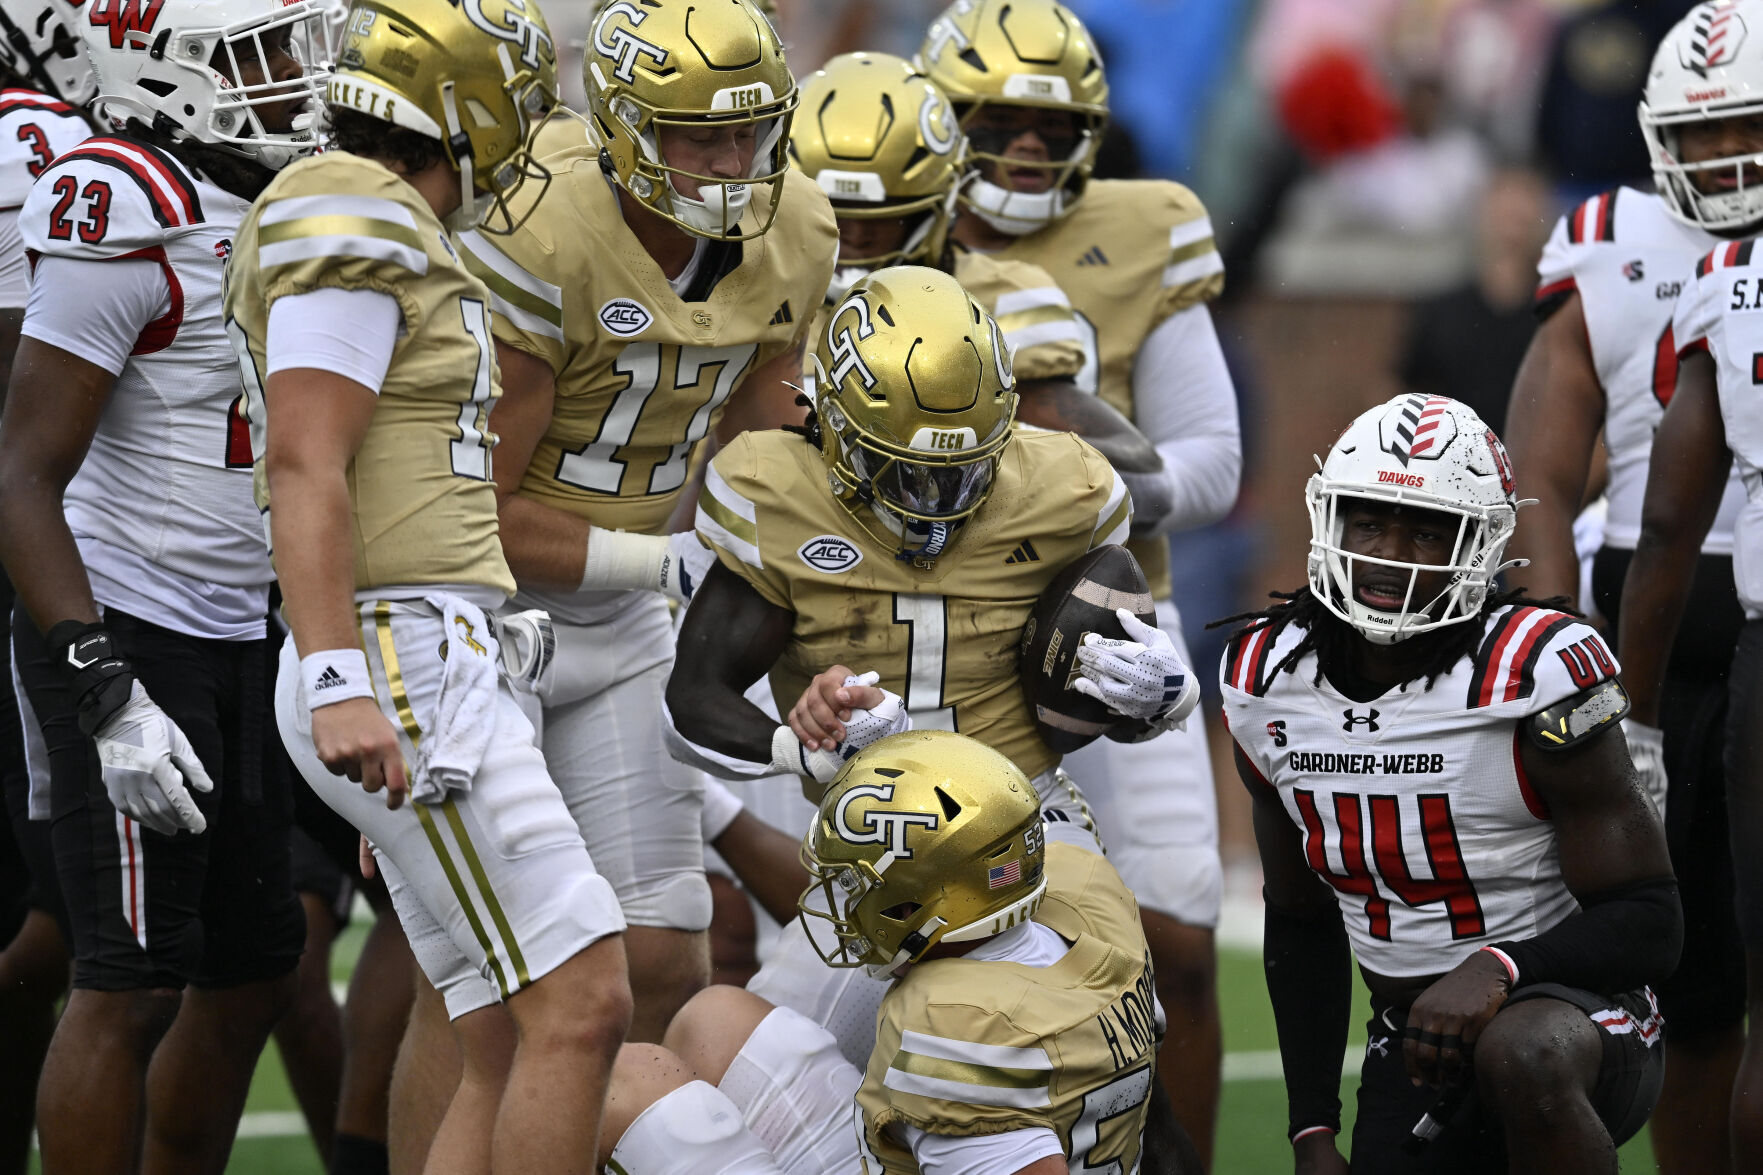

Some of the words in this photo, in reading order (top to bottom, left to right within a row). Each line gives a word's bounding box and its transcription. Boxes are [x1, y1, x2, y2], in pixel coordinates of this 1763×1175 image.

[350, 7, 378, 37] 12
[594, 2, 669, 86] GT
[730, 88, 762, 109] TECH
[48, 175, 113, 245] 23
[606, 308, 640, 323] ACC
[827, 294, 878, 393] GT
[554, 341, 761, 496] 17
[930, 431, 964, 450] TECH
[810, 545, 850, 559] ACC
[1367, 614, 1393, 626] Riddell
[892, 592, 959, 733] 1
[315, 678, 347, 691] adidas
[1289, 751, 1444, 774] GARDNER-WEBB
[834, 784, 939, 860] GT
[1292, 786, 1487, 942] 44
